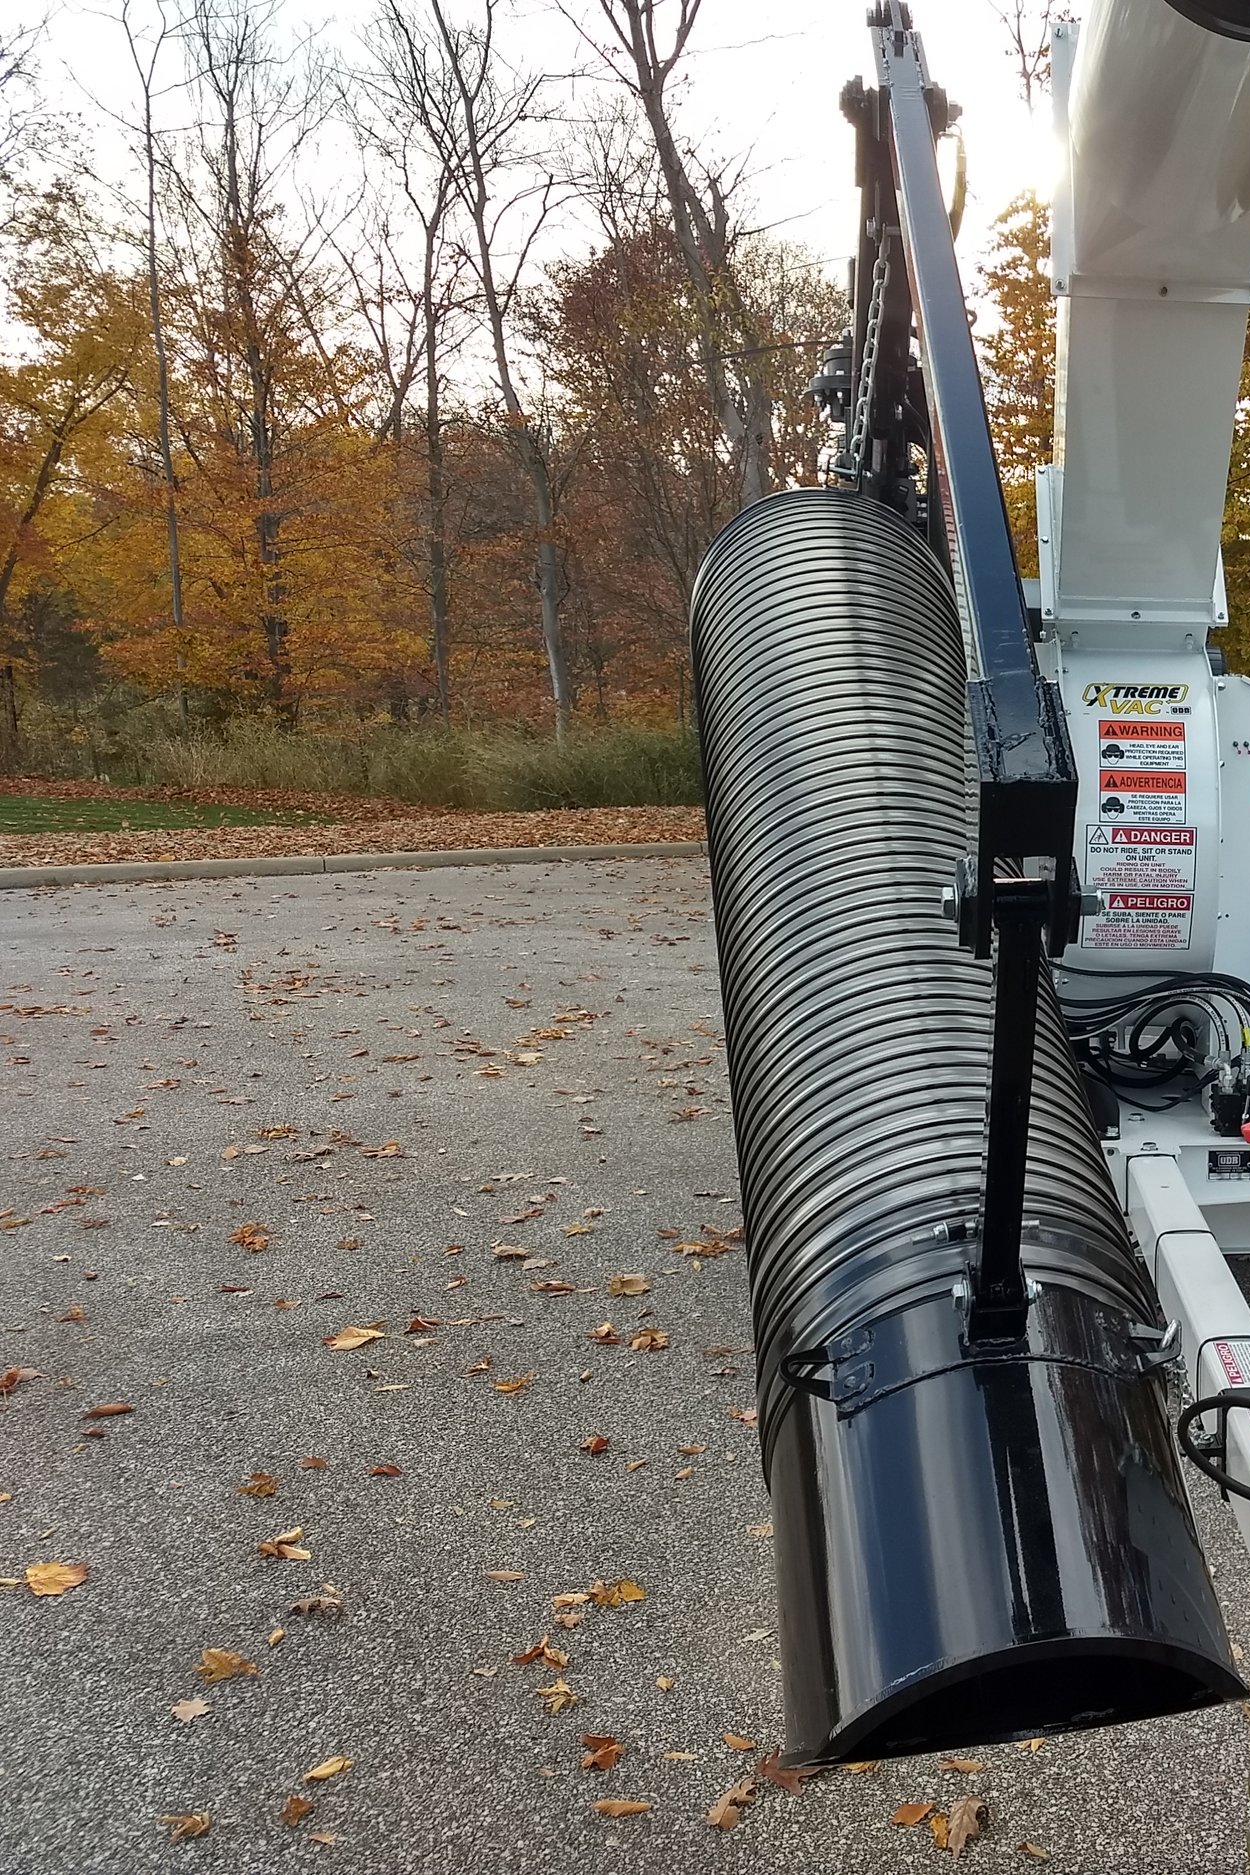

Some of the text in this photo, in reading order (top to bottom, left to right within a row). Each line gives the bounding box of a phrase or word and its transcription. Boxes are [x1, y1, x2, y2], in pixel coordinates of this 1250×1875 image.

[1086, 684, 1181, 707] XTREME
[1110, 699, 1163, 715] VAC
[1118, 725, 1183, 737] WARNING
[1120, 776, 1183, 789] ADVERTENCIA
[1131, 831, 1190, 843] DANGER
[1141, 847, 1154, 855] SIT
[1128, 897, 1187, 909] PELIGRO
[1217, 1343, 1241, 1378] PELIGRO
